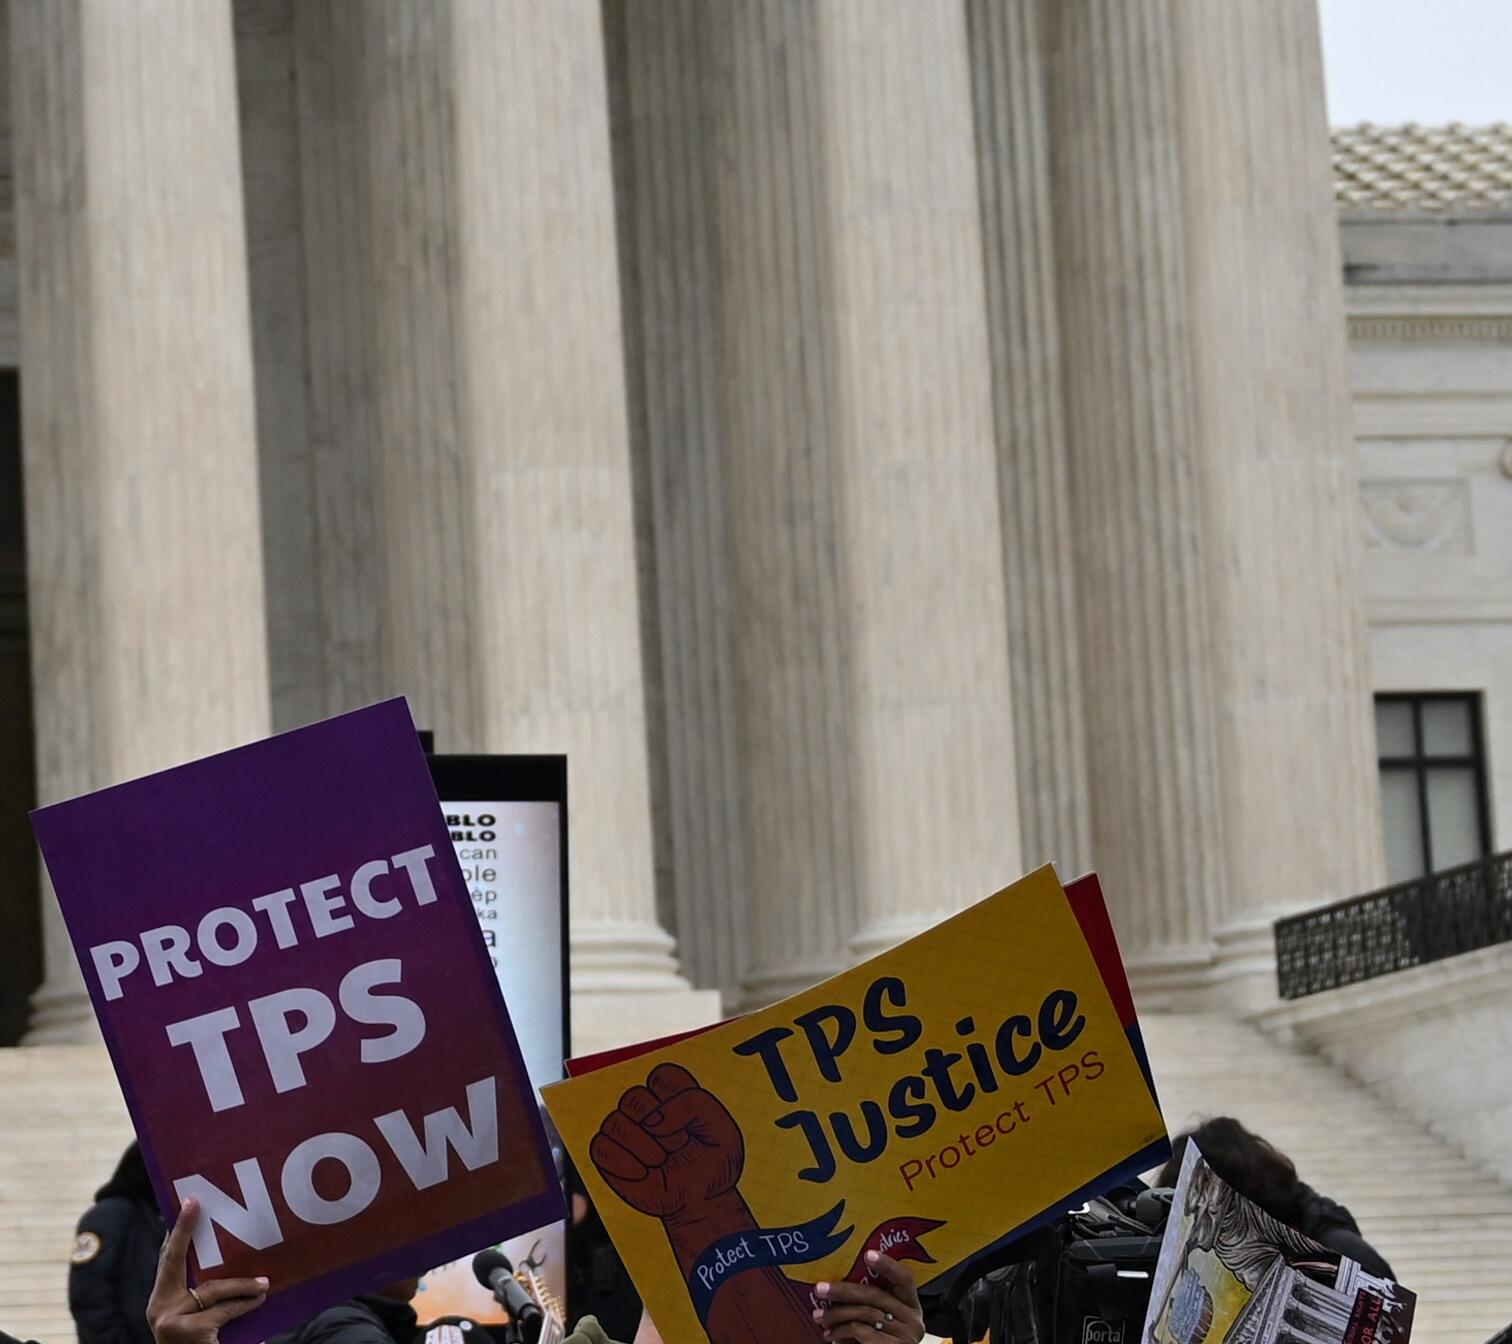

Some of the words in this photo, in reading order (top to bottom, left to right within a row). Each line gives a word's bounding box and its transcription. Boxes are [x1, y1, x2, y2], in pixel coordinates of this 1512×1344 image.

[89, 844, 438, 1002] PROTECT
[165, 958, 427, 1113] TPS
[732, 976, 923, 1103] TPS
[173, 1075, 500, 1271] NOW
[898, 1100, 1031, 1192] Protect
[1034, 1049, 1106, 1108] TPS
[697, 1238, 756, 1290] Protect
[759, 1230, 809, 1258] TPS
